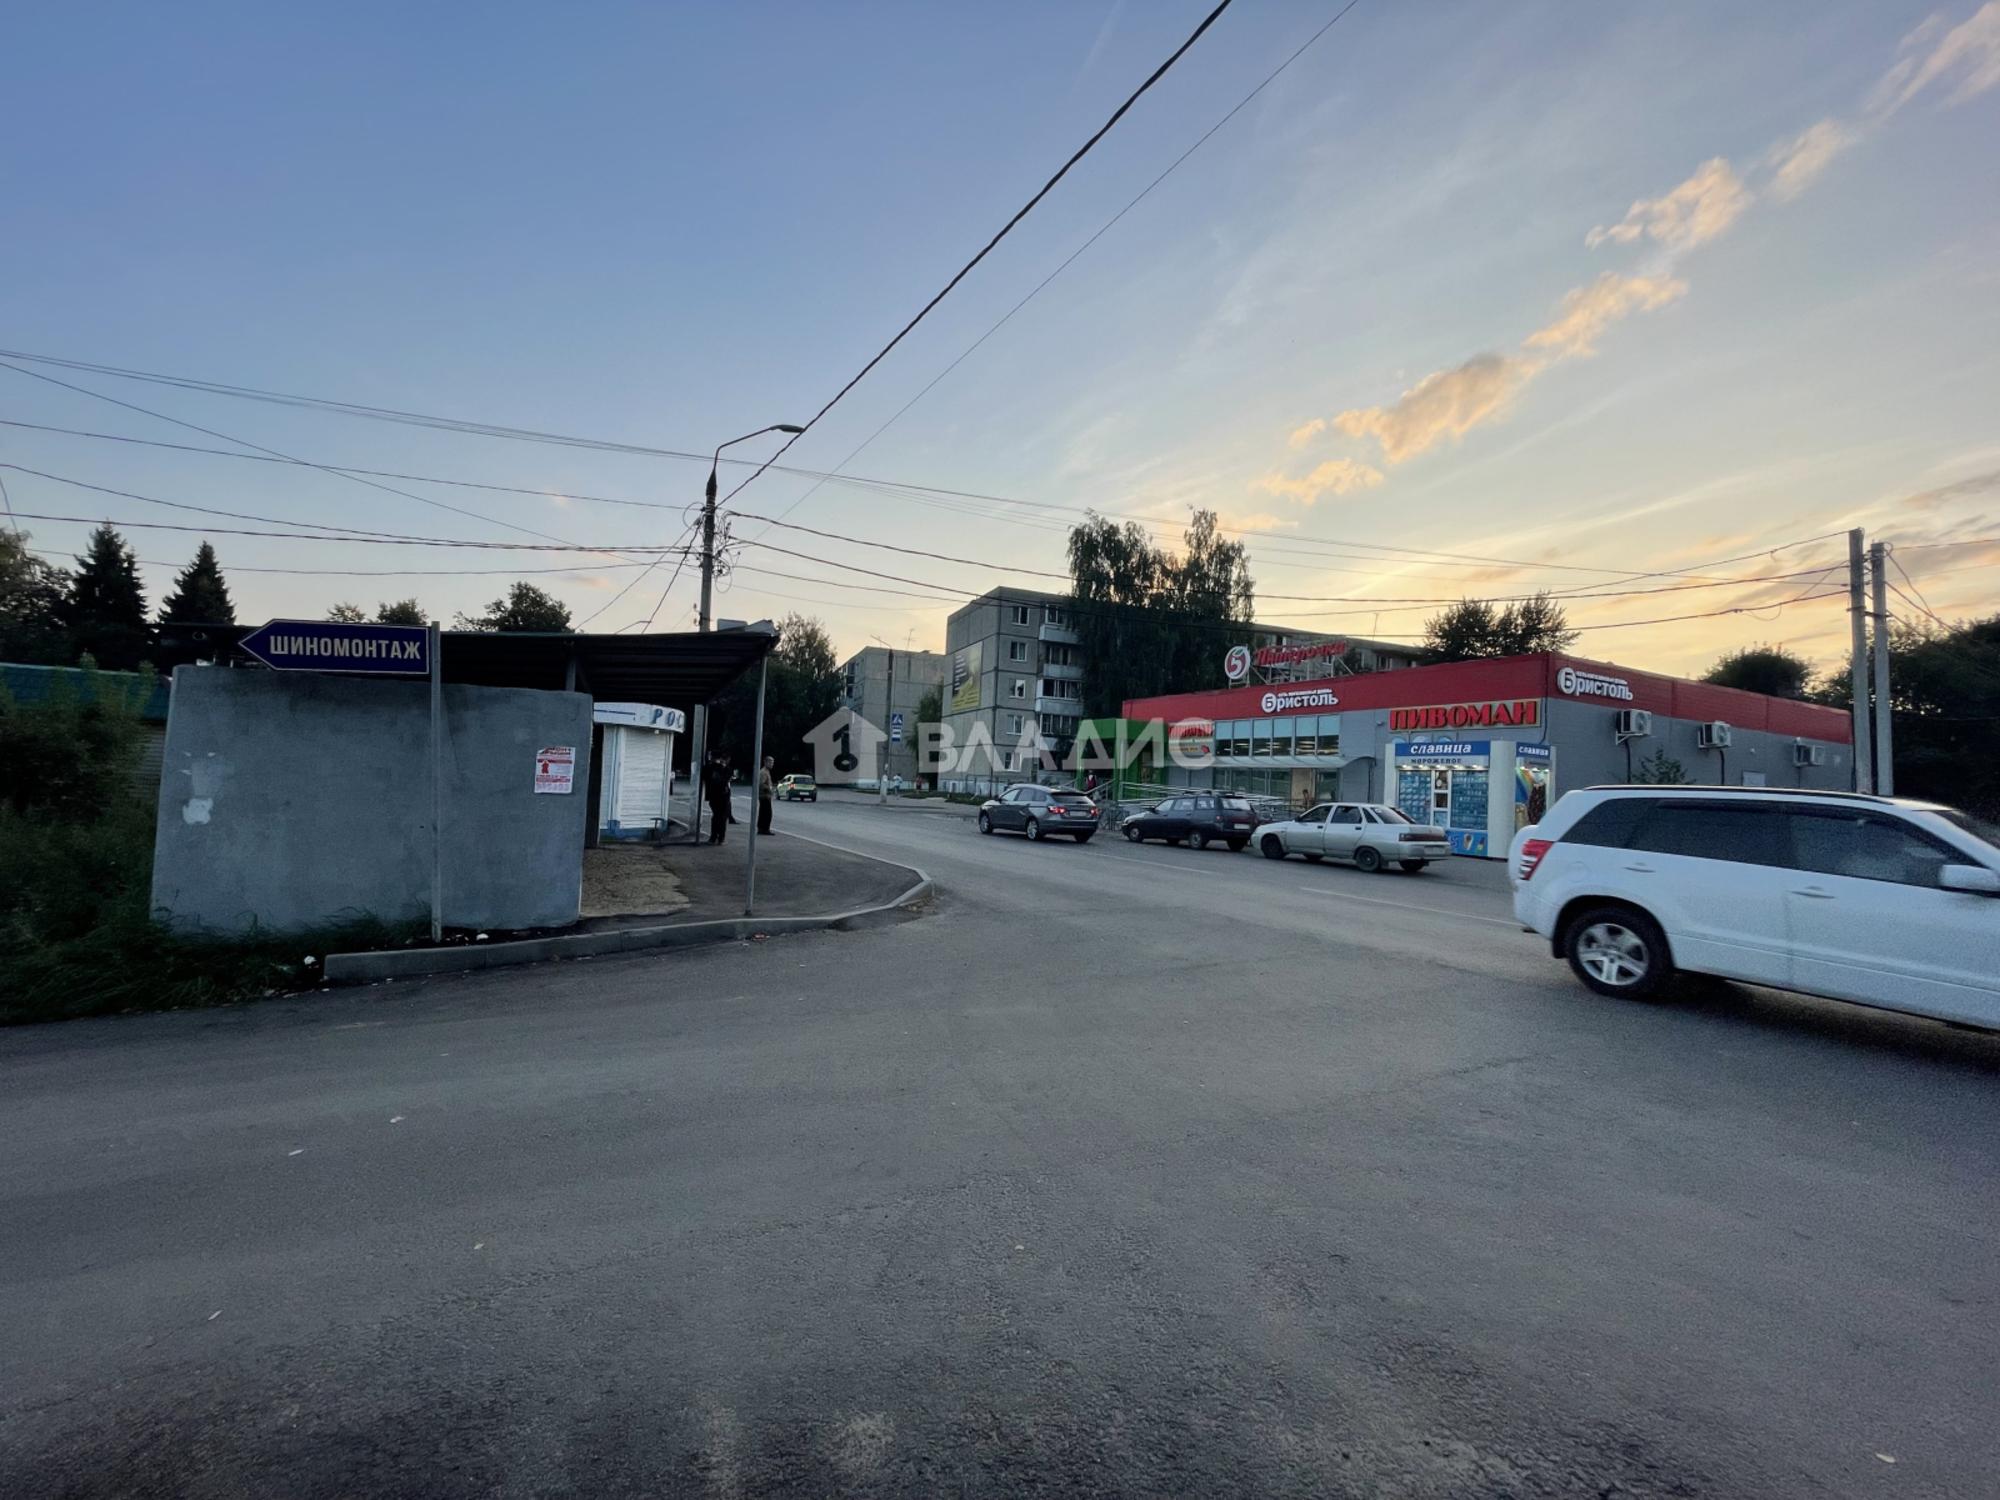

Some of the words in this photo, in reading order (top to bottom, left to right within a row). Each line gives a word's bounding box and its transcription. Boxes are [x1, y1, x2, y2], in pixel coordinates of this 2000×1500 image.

[269, 635, 421, 660] ШИНОМОНТАЖ
[1557, 667, 1634, 701] Бристоль
[1261, 692, 1339, 713] Бристоль
[1389, 701, 1537, 731] ПИВОМАН
